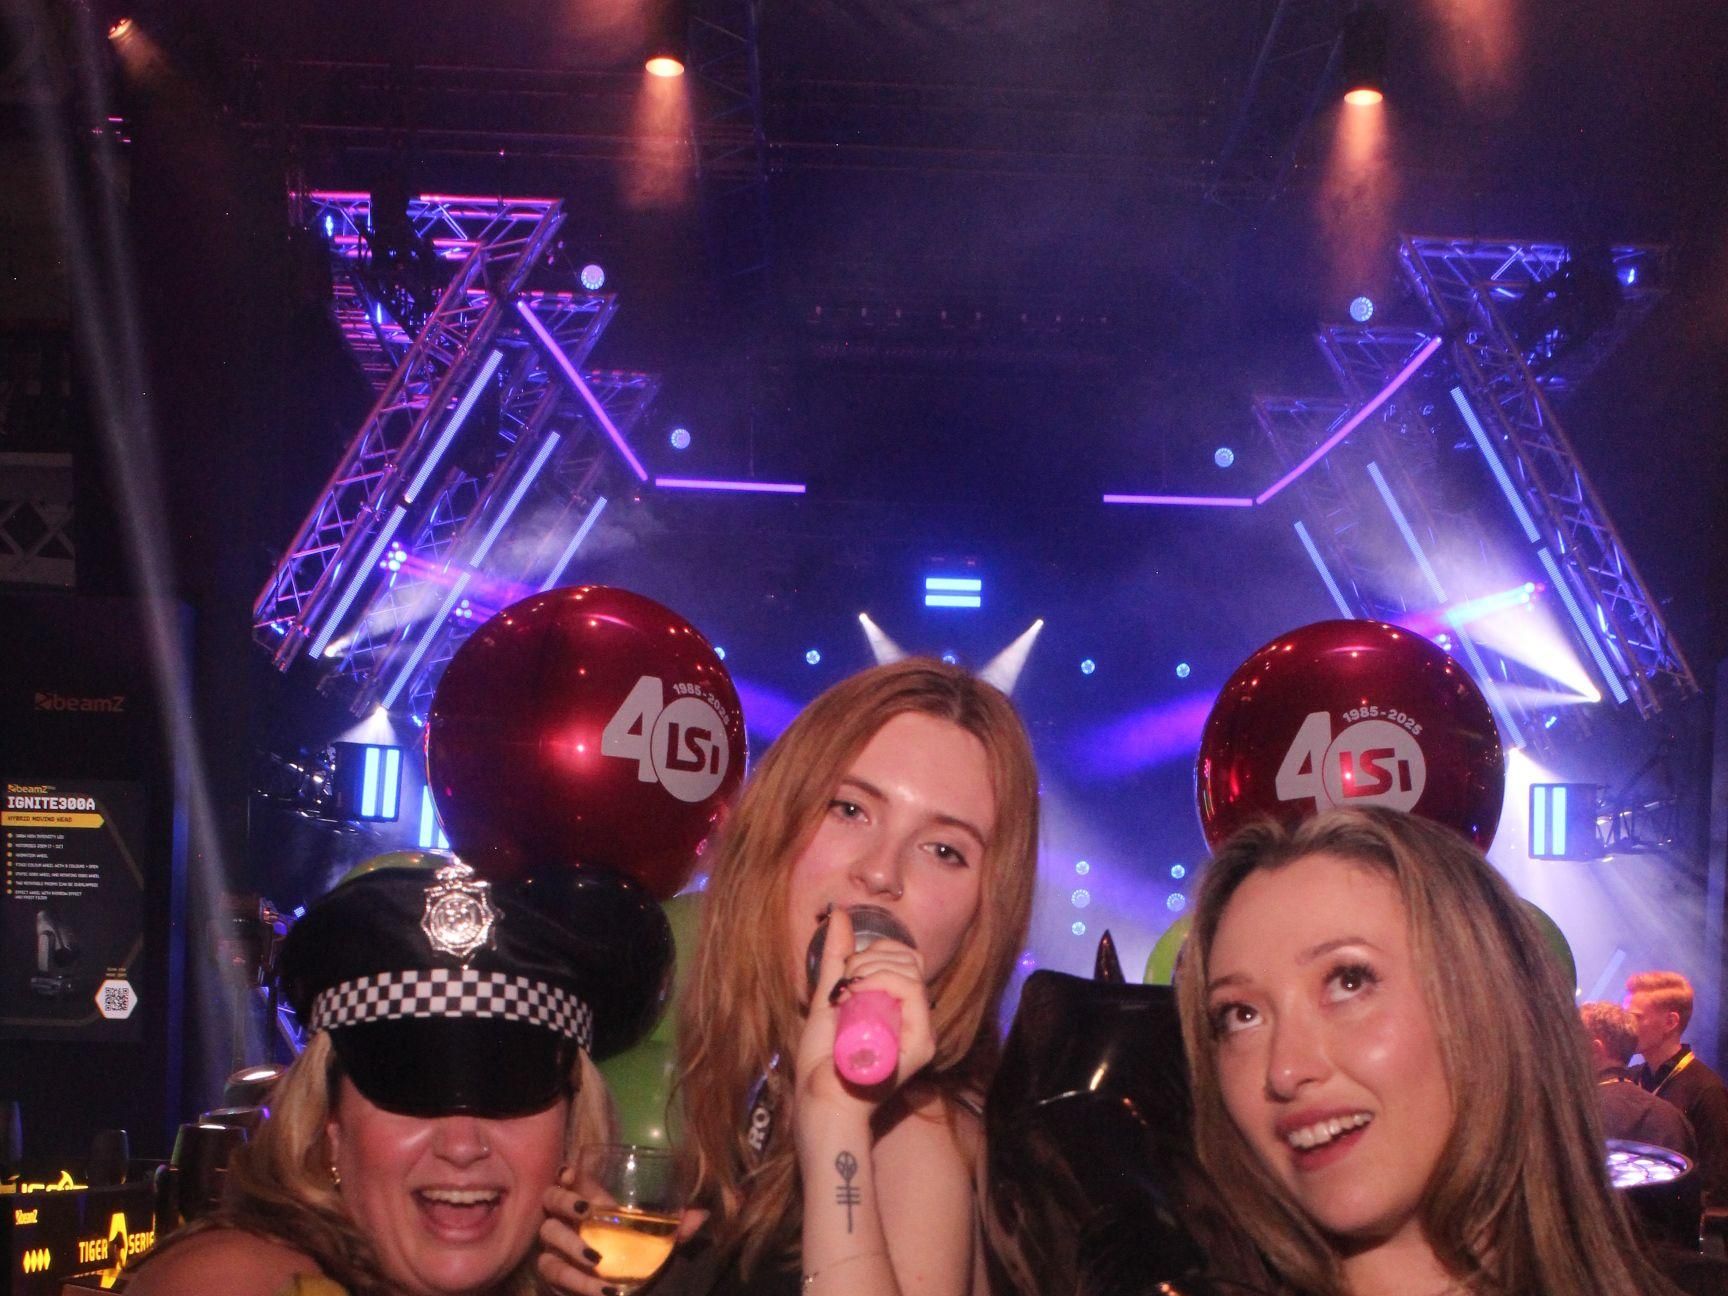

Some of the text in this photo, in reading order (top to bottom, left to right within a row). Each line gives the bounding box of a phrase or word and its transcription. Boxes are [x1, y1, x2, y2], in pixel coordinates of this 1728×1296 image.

[54, 695, 125, 712] beamZ
[1342, 705, 1423, 736] 1985-2025
[16, 785, 48, 793] beamZ
[7, 796, 96, 810] IGNITE300A
[79, 1231, 155, 1263] TIGER SERIE
